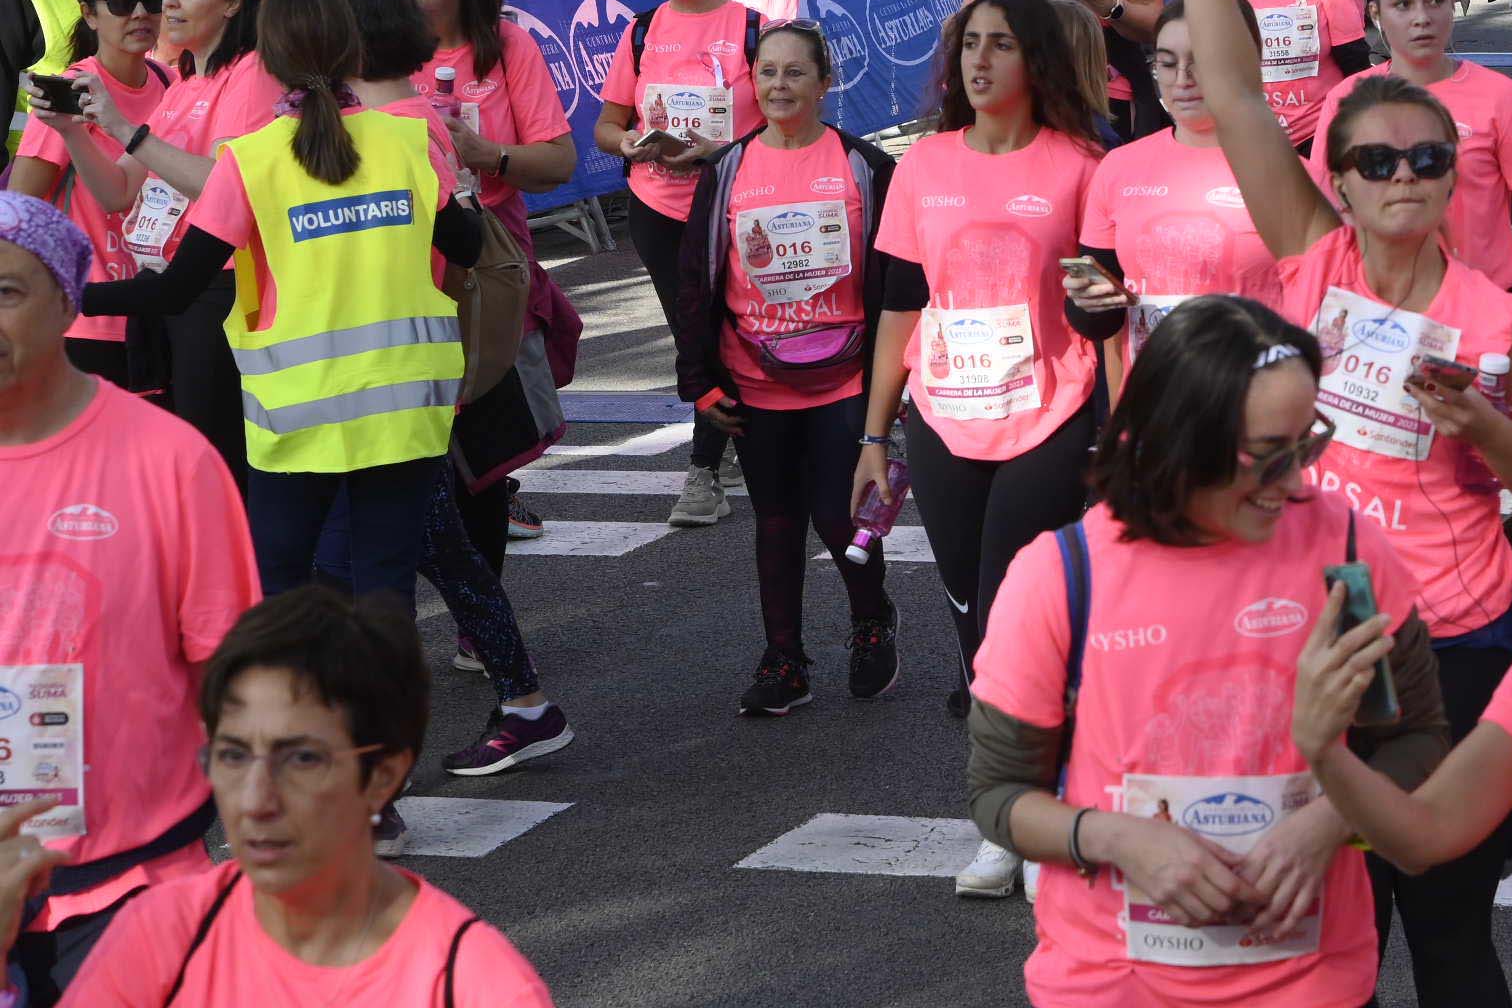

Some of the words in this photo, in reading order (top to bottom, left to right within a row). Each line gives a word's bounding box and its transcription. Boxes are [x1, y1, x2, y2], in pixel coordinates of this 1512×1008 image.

[1264, 36, 1292, 48] 016
[671, 116, 702, 129] 016
[734, 184, 776, 204] OYSHO
[1122, 185, 1168, 197] OYSHO
[921, 195, 967, 209] OYSHO
[291, 198, 411, 232] VOLUNTARIS
[770, 218, 812, 233] ASTURIANA
[775, 241, 813, 257] 016
[782, 258, 810, 270] 12982
[953, 353, 992, 370] 016
[1343, 355, 1393, 385] 016
[1342, 380, 1379, 402] 10932
[1365, 406, 1396, 425] MUJER
[1190, 808, 1268, 827] ASTURIANA
[1143, 930, 1205, 952] OYSHO
